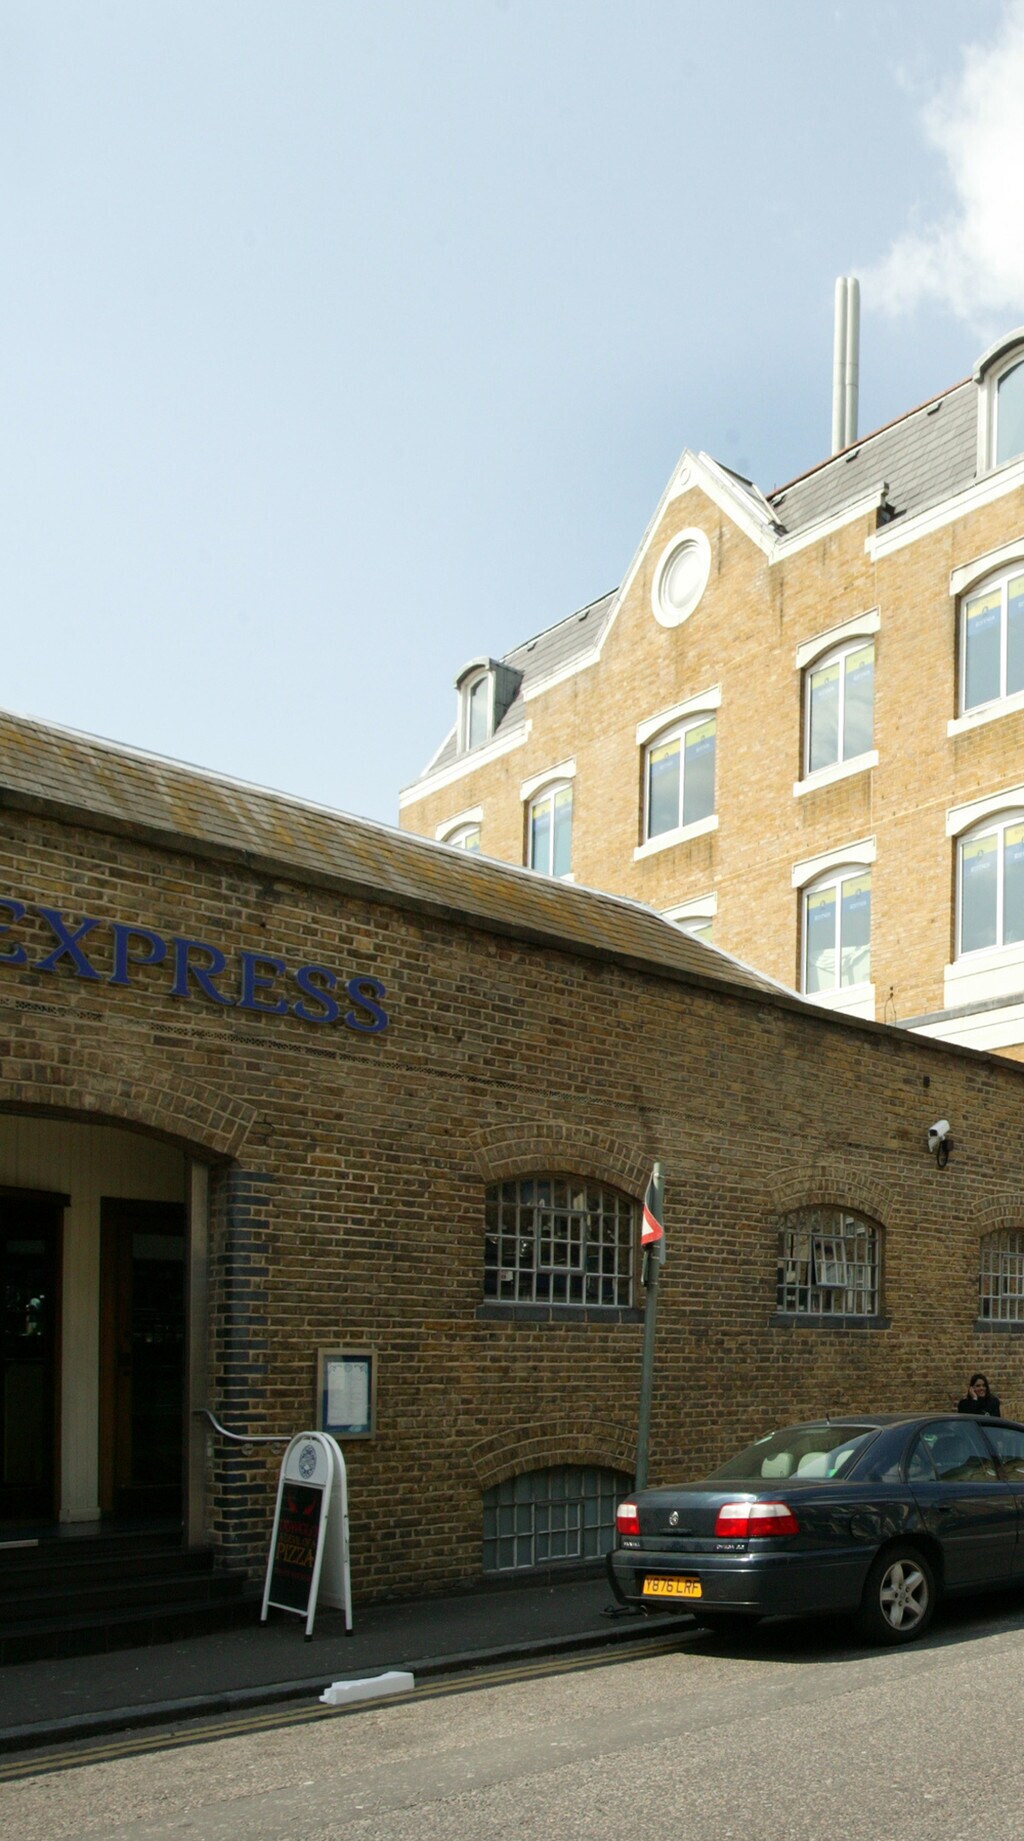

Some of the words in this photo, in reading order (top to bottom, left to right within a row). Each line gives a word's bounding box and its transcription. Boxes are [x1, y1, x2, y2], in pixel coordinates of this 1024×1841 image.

[276, 1542, 314, 1567] PIZZA
[645, 1578, 674, 1593] Y876
[676, 1579, 699, 1594] LRF
